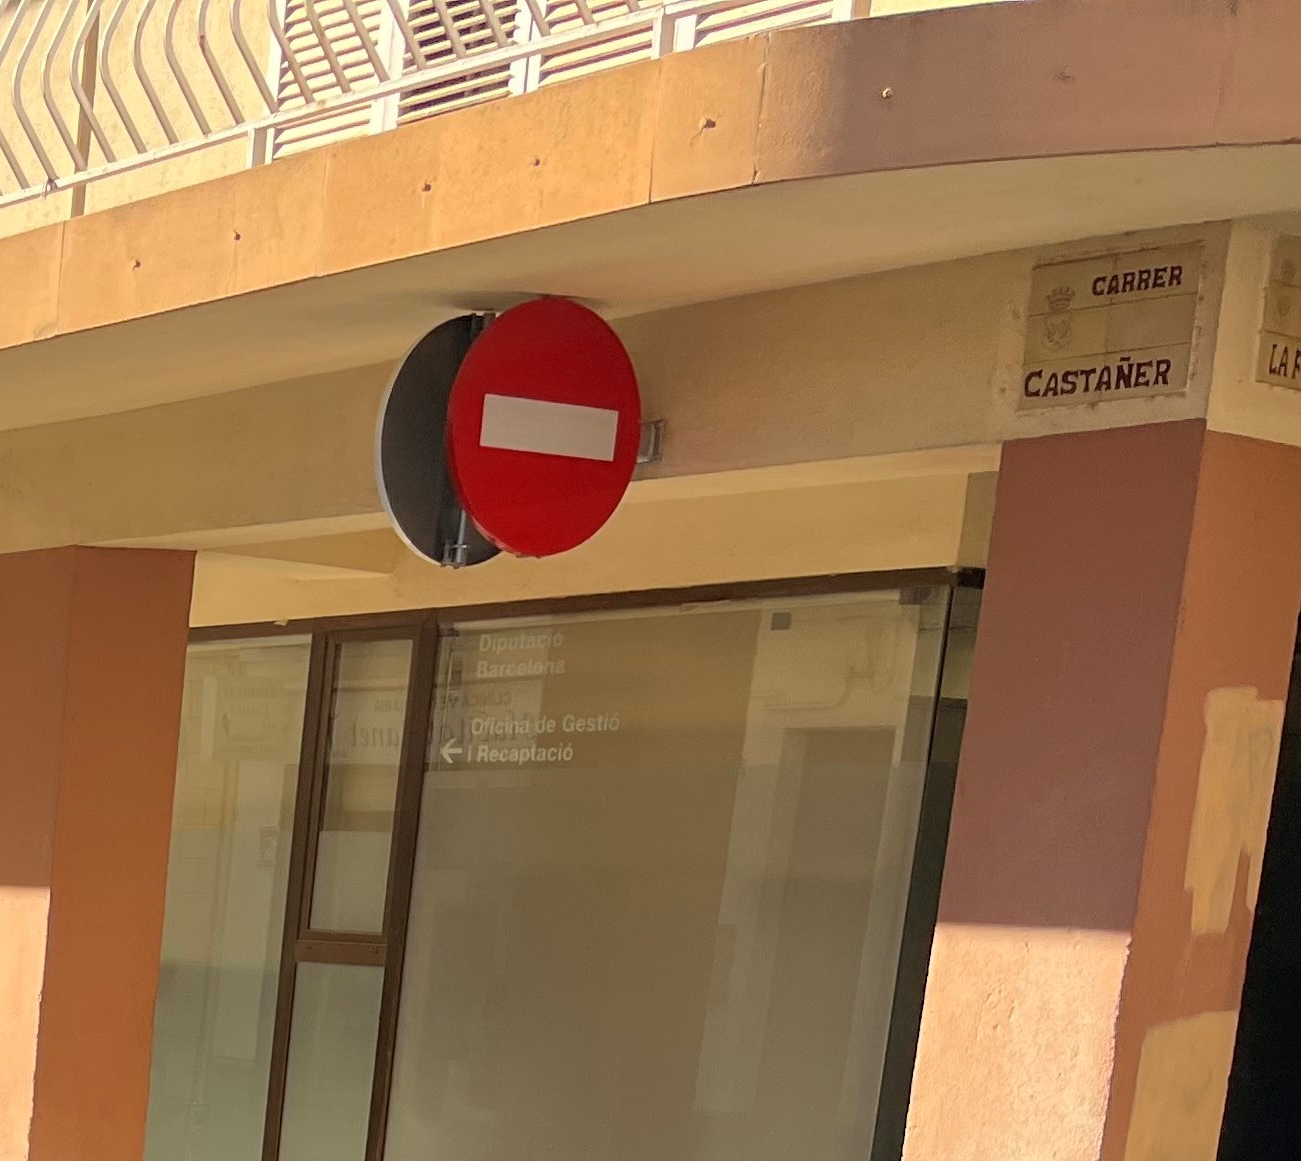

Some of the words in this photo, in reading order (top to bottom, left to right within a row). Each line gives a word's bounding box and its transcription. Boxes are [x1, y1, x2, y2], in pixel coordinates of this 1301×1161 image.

[1091, 265, 1184, 297] CARRER
[1268, 343, 1288, 377] LA
[1023, 356, 1172, 398] CASTAÑER
[478, 630, 566, 655] Diputació
[476, 658, 567, 680] Barcelona
[470, 715, 531, 736] Oficina
[534, 714, 556, 734] de
[562, 711, 621, 733] Gestió
[467, 746, 473, 763] i
[476, 741, 574, 766] Recaptació
